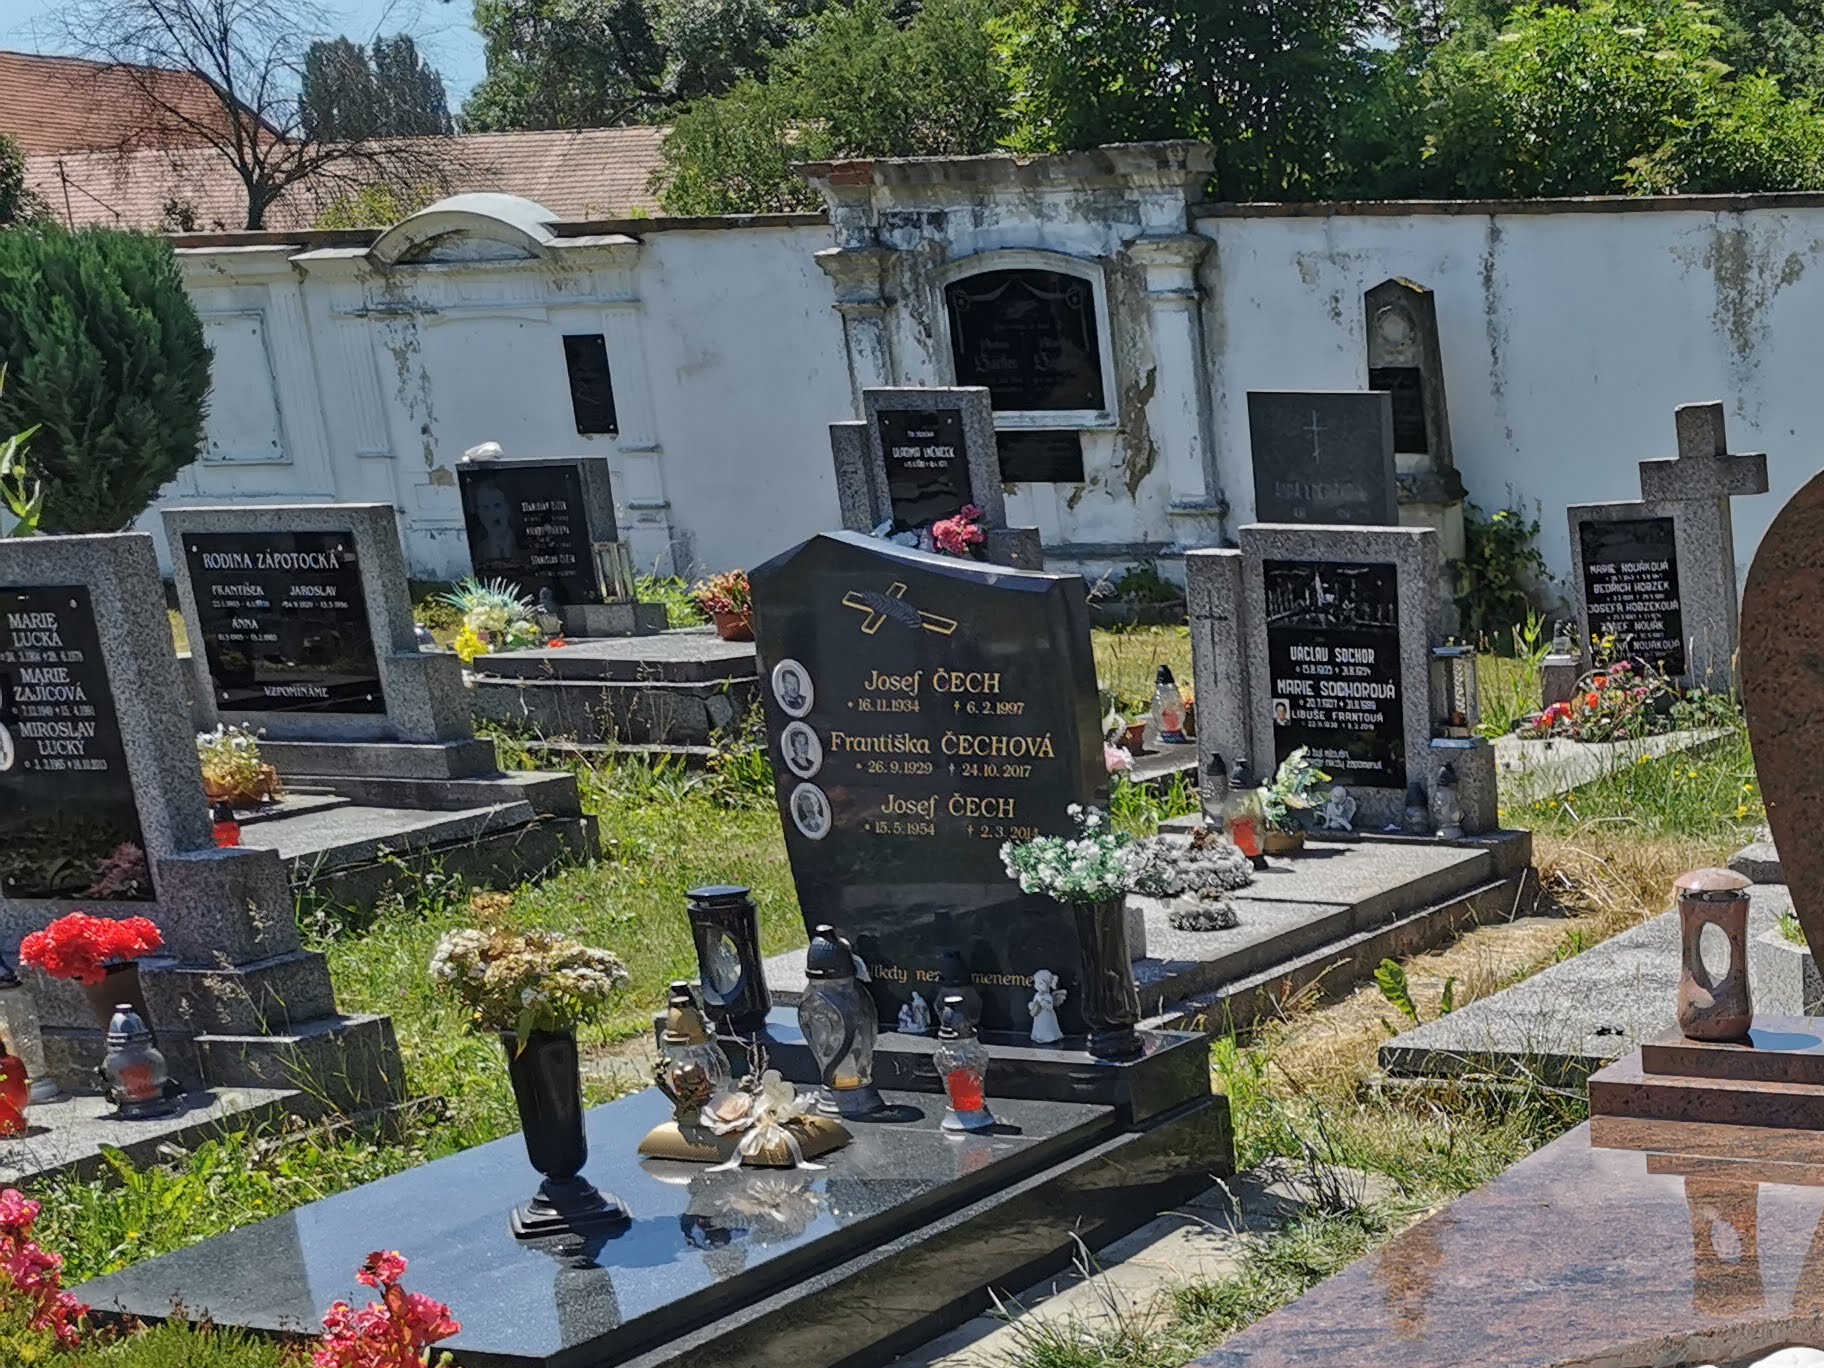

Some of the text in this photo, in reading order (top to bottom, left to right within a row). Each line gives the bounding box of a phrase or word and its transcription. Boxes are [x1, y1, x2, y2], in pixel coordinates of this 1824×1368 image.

[203, 548, 339, 570] RODINA ZÁPOTOCKÁ
[289, 585, 337, 597] JAROSLAV
[7, 613, 57, 629] MARIE
[1335, 647, 1375, 664] SOCHOR
[19, 667, 70, 684] MARIE
[864, 667, 1001, 697] Josef ČECH
[13, 682, 88, 701] ZAJÍCOVÁ
[1277, 679, 1314, 696] MARIE
[1291, 708, 1326, 721] LIBUŠE
[18, 721, 96, 738] MIROSLAV
[830, 730, 1055, 758] Františka ČECHOVÁ
[881, 792, 1016, 820] Josef ČECH
